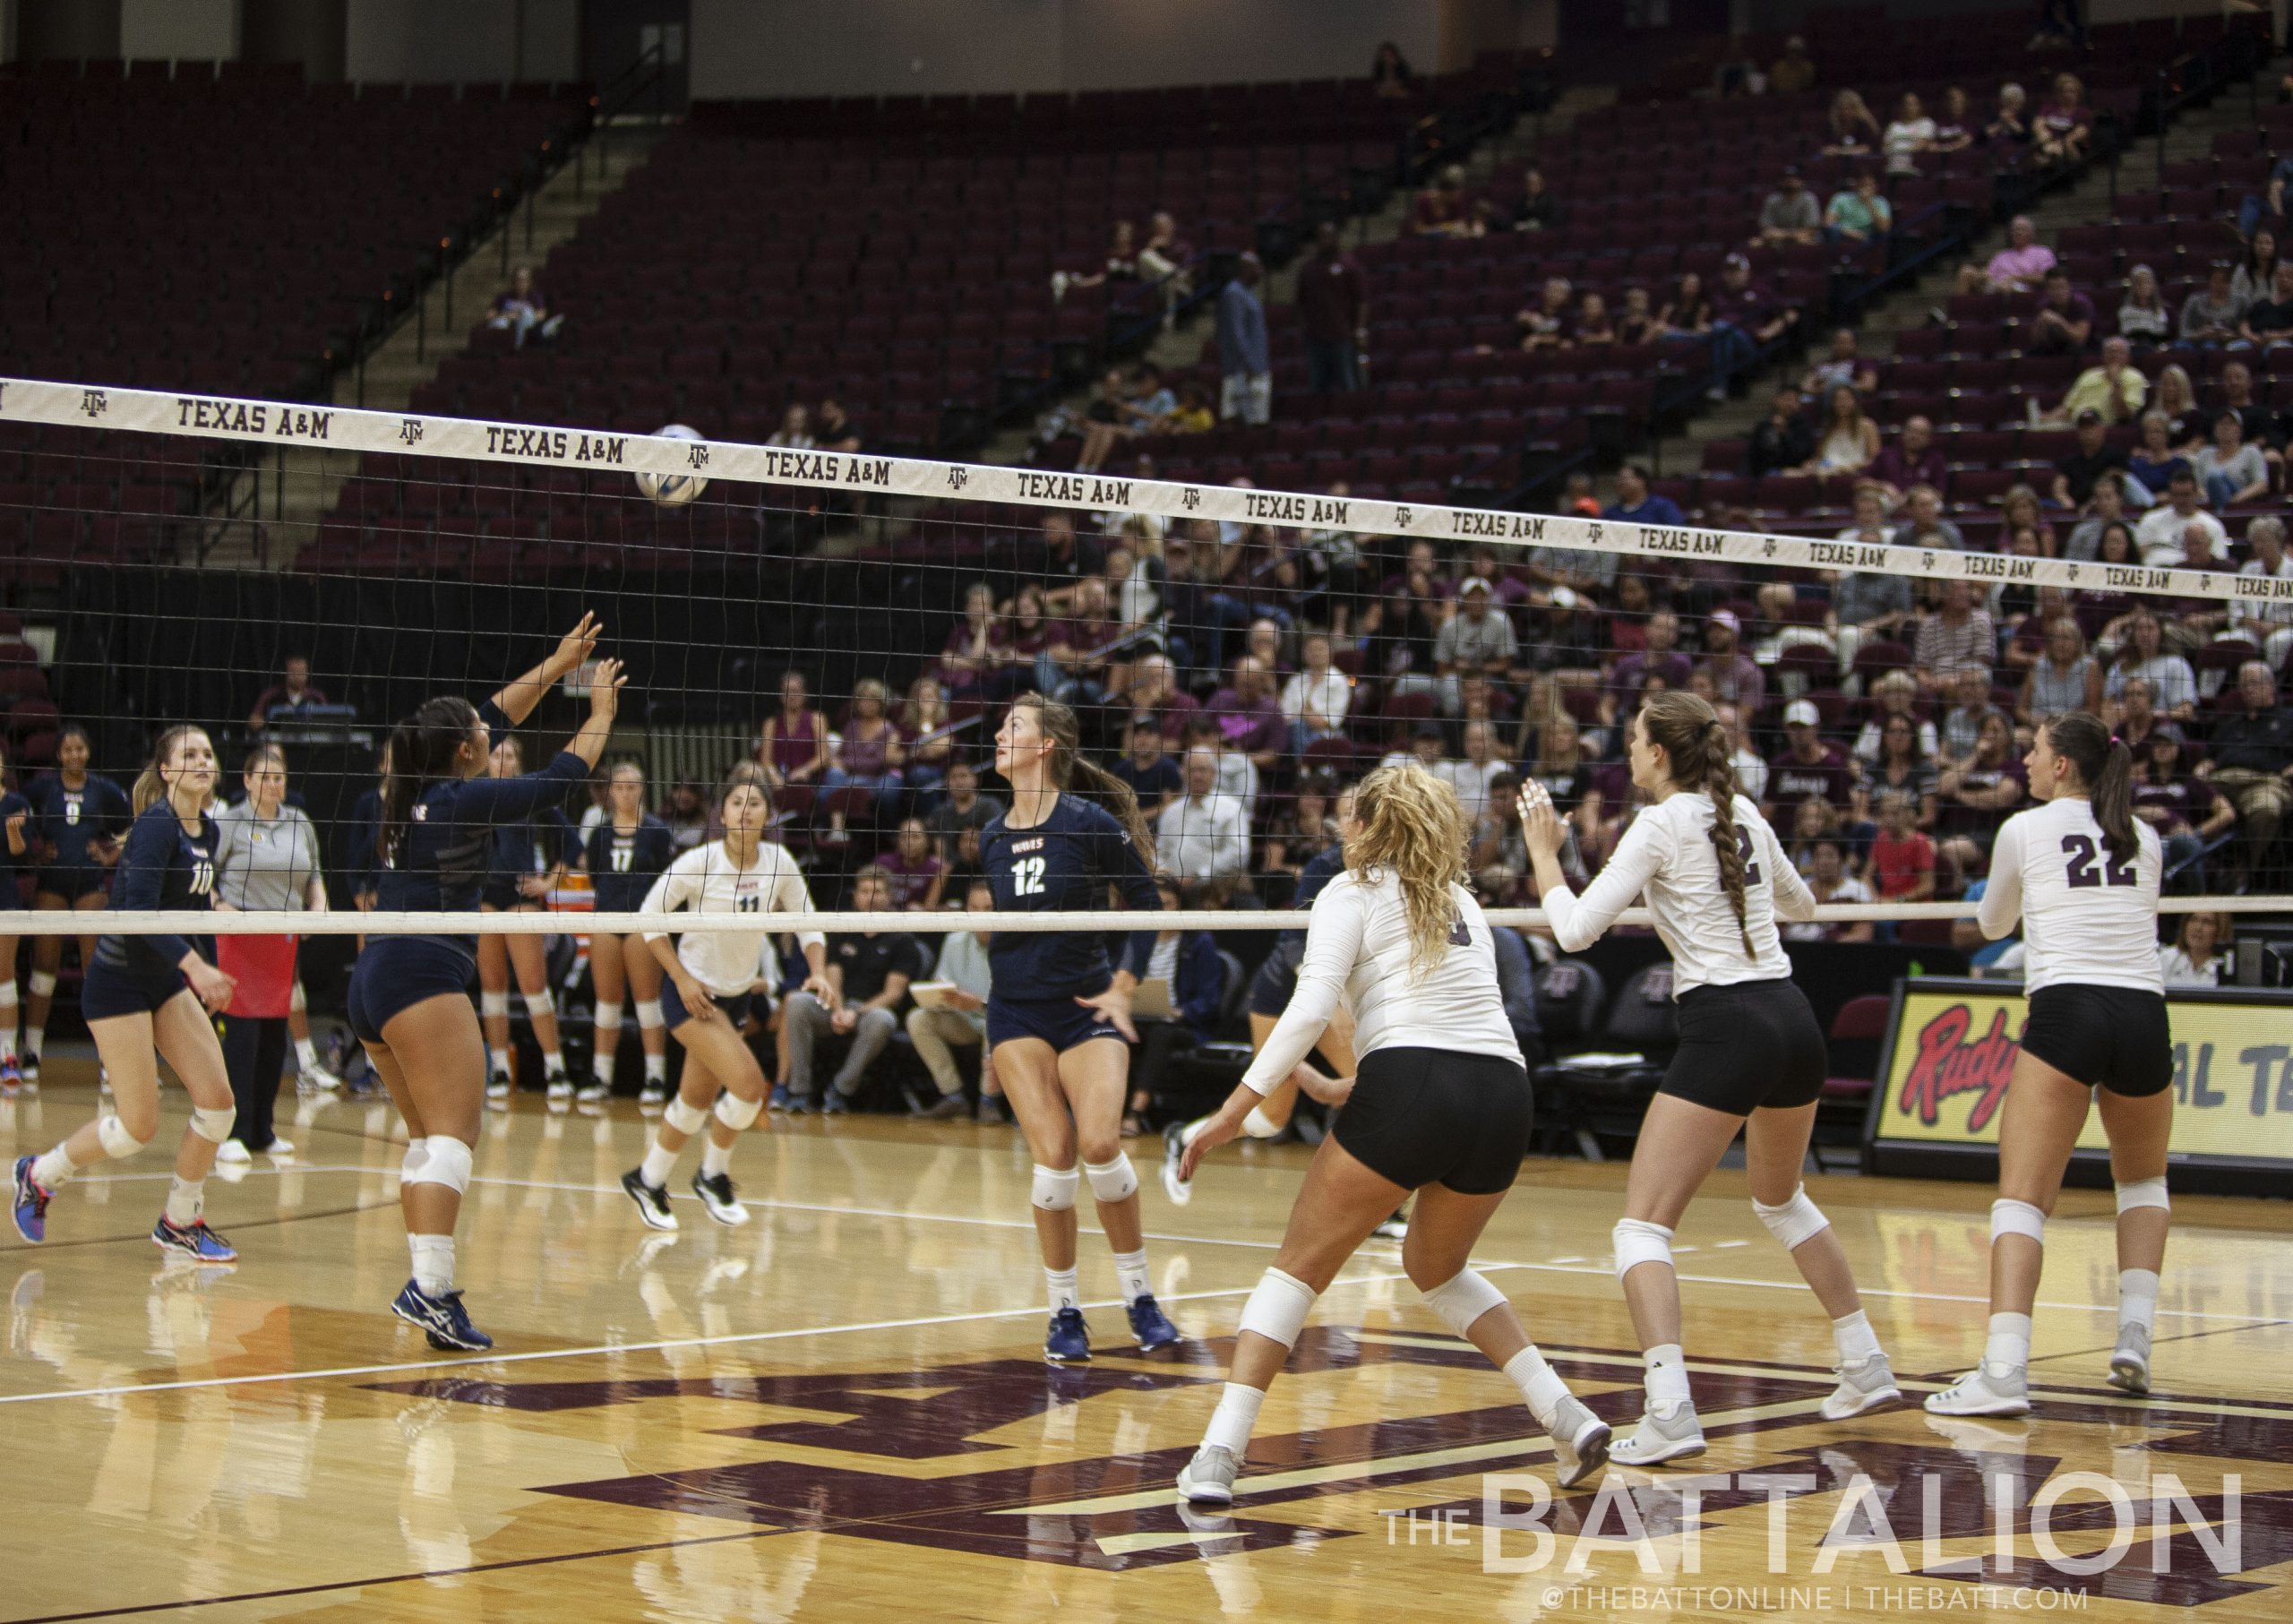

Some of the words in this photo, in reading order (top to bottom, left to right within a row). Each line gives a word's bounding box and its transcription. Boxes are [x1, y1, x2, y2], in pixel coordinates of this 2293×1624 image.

[178, 399, 266, 434] TEXAS
[276, 408, 330, 439] A&M
[486, 426, 568, 459] TEXAS
[576, 435, 625, 464] A&M
[766, 451, 839, 481] TEXAS
[846, 459, 890, 485] A&M
[1018, 473, 1084, 501] TEXAS
[1090, 479, 1130, 505] A&M
[1246, 494, 1305, 521] TEXAS
[1311, 500, 1348, 524] A&M
[1453, 511, 1507, 537] TEXAS
[1512, 518, 1546, 539] A&M
[1639, 528, 1689, 552] TEXAS
[1693, 533, 1724, 554] A&M
[1809, 543, 1854, 565] TEXAS
[1964, 555, 2005, 577] TEXAS
[2107, 567, 2143, 587] TEXAS
[1010, 857, 1046, 896] 12
